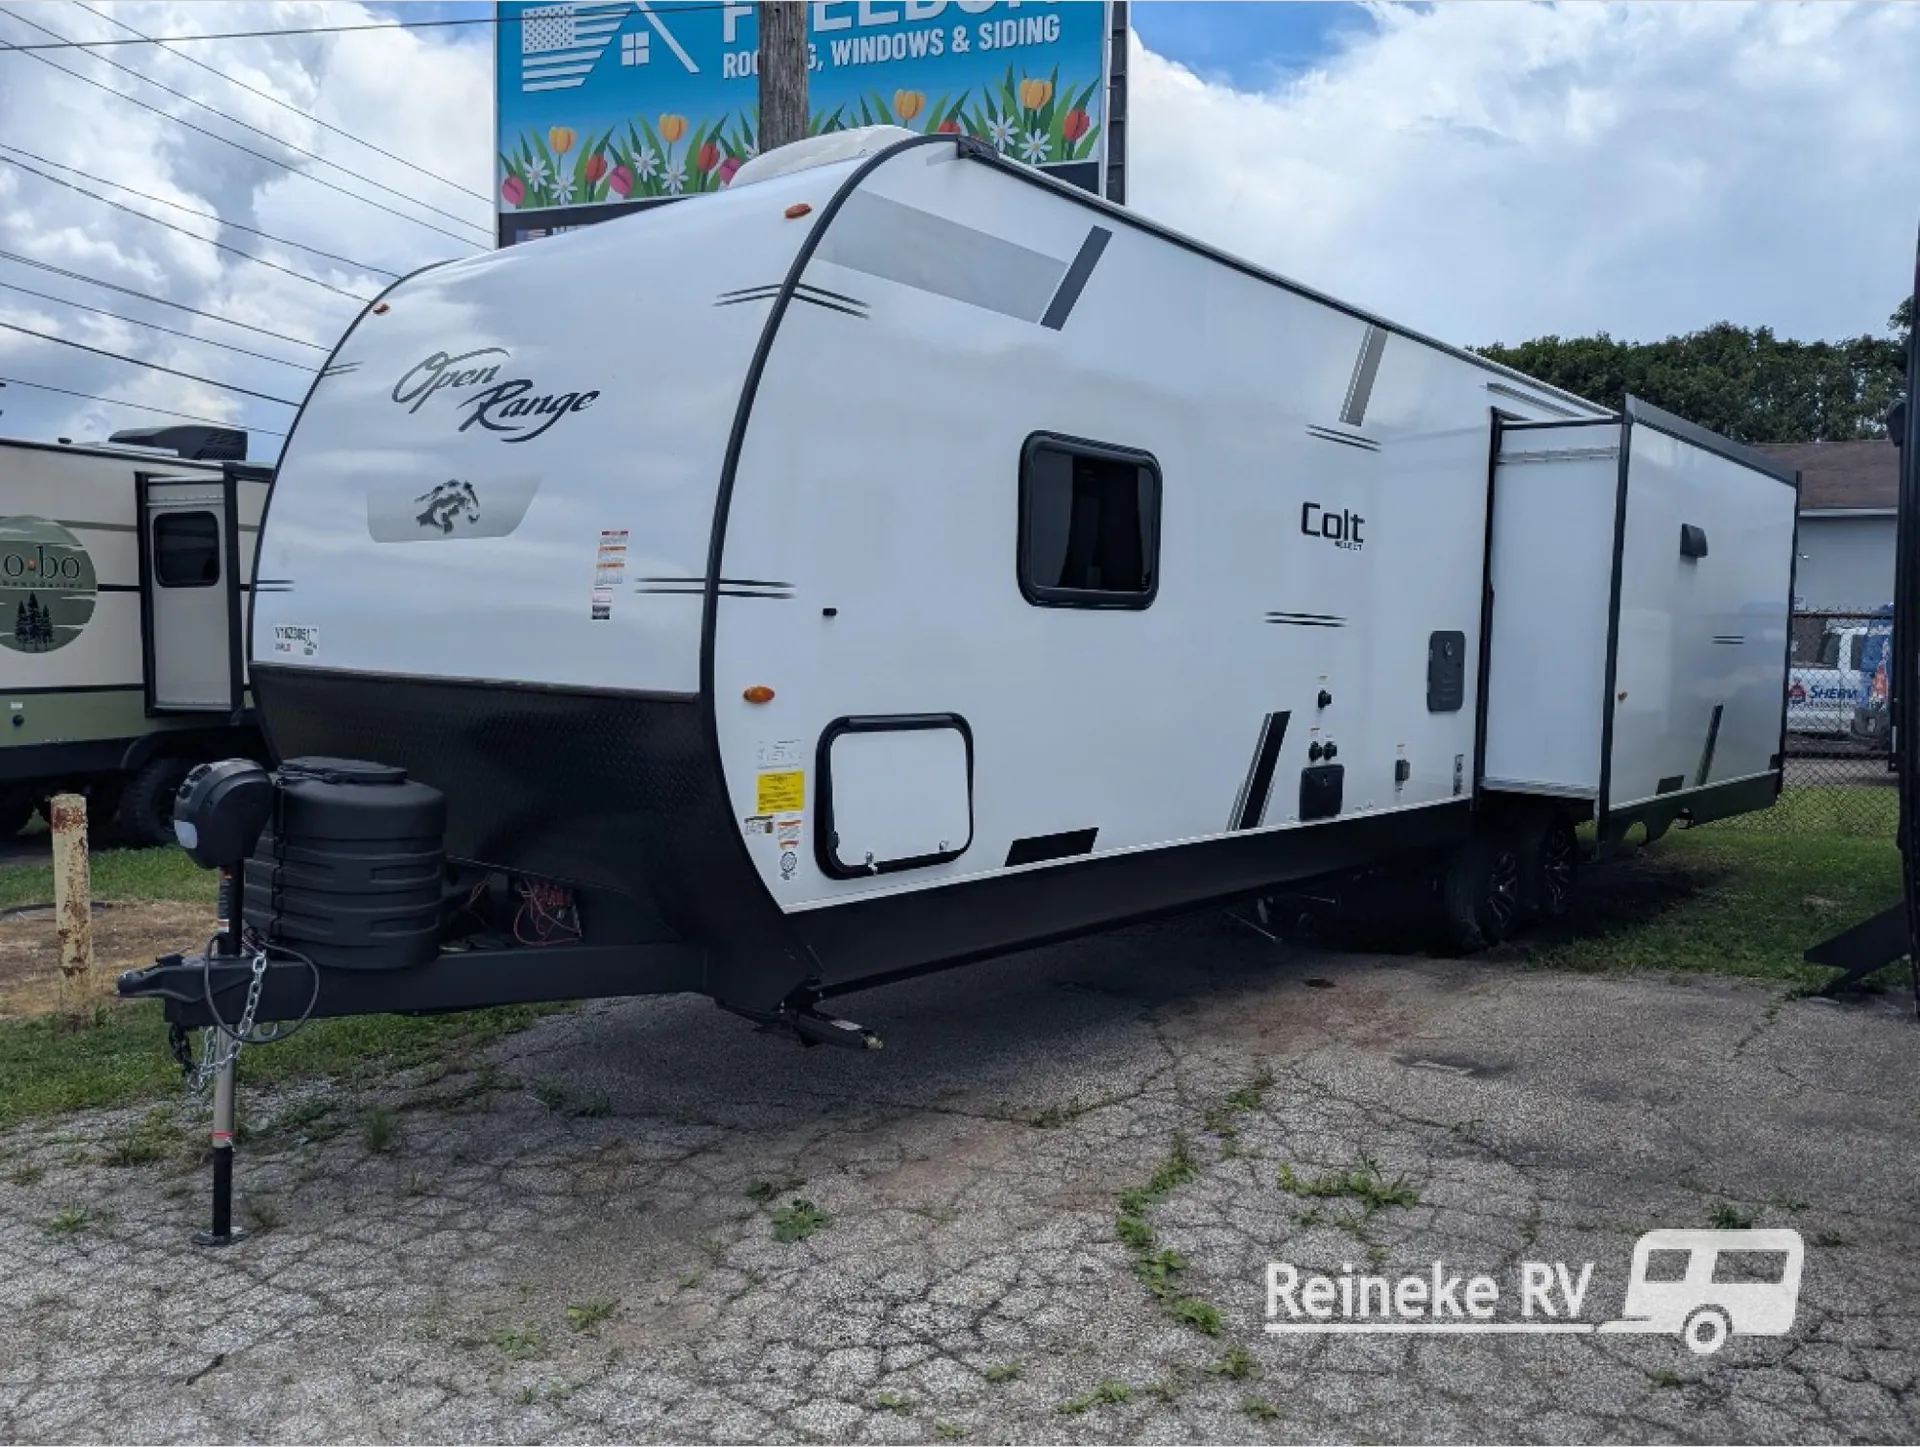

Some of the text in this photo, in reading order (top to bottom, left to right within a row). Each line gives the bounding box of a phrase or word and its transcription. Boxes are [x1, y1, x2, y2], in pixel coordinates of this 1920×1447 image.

[831, 28, 944, 67] WINDOWS
[952, 25, 970, 53] &
[978, 13, 1061, 51] SIDING
[392, 347, 511, 414] Open
[456, 378, 600, 443] Range
[1301, 501, 1365, 543] Colt
